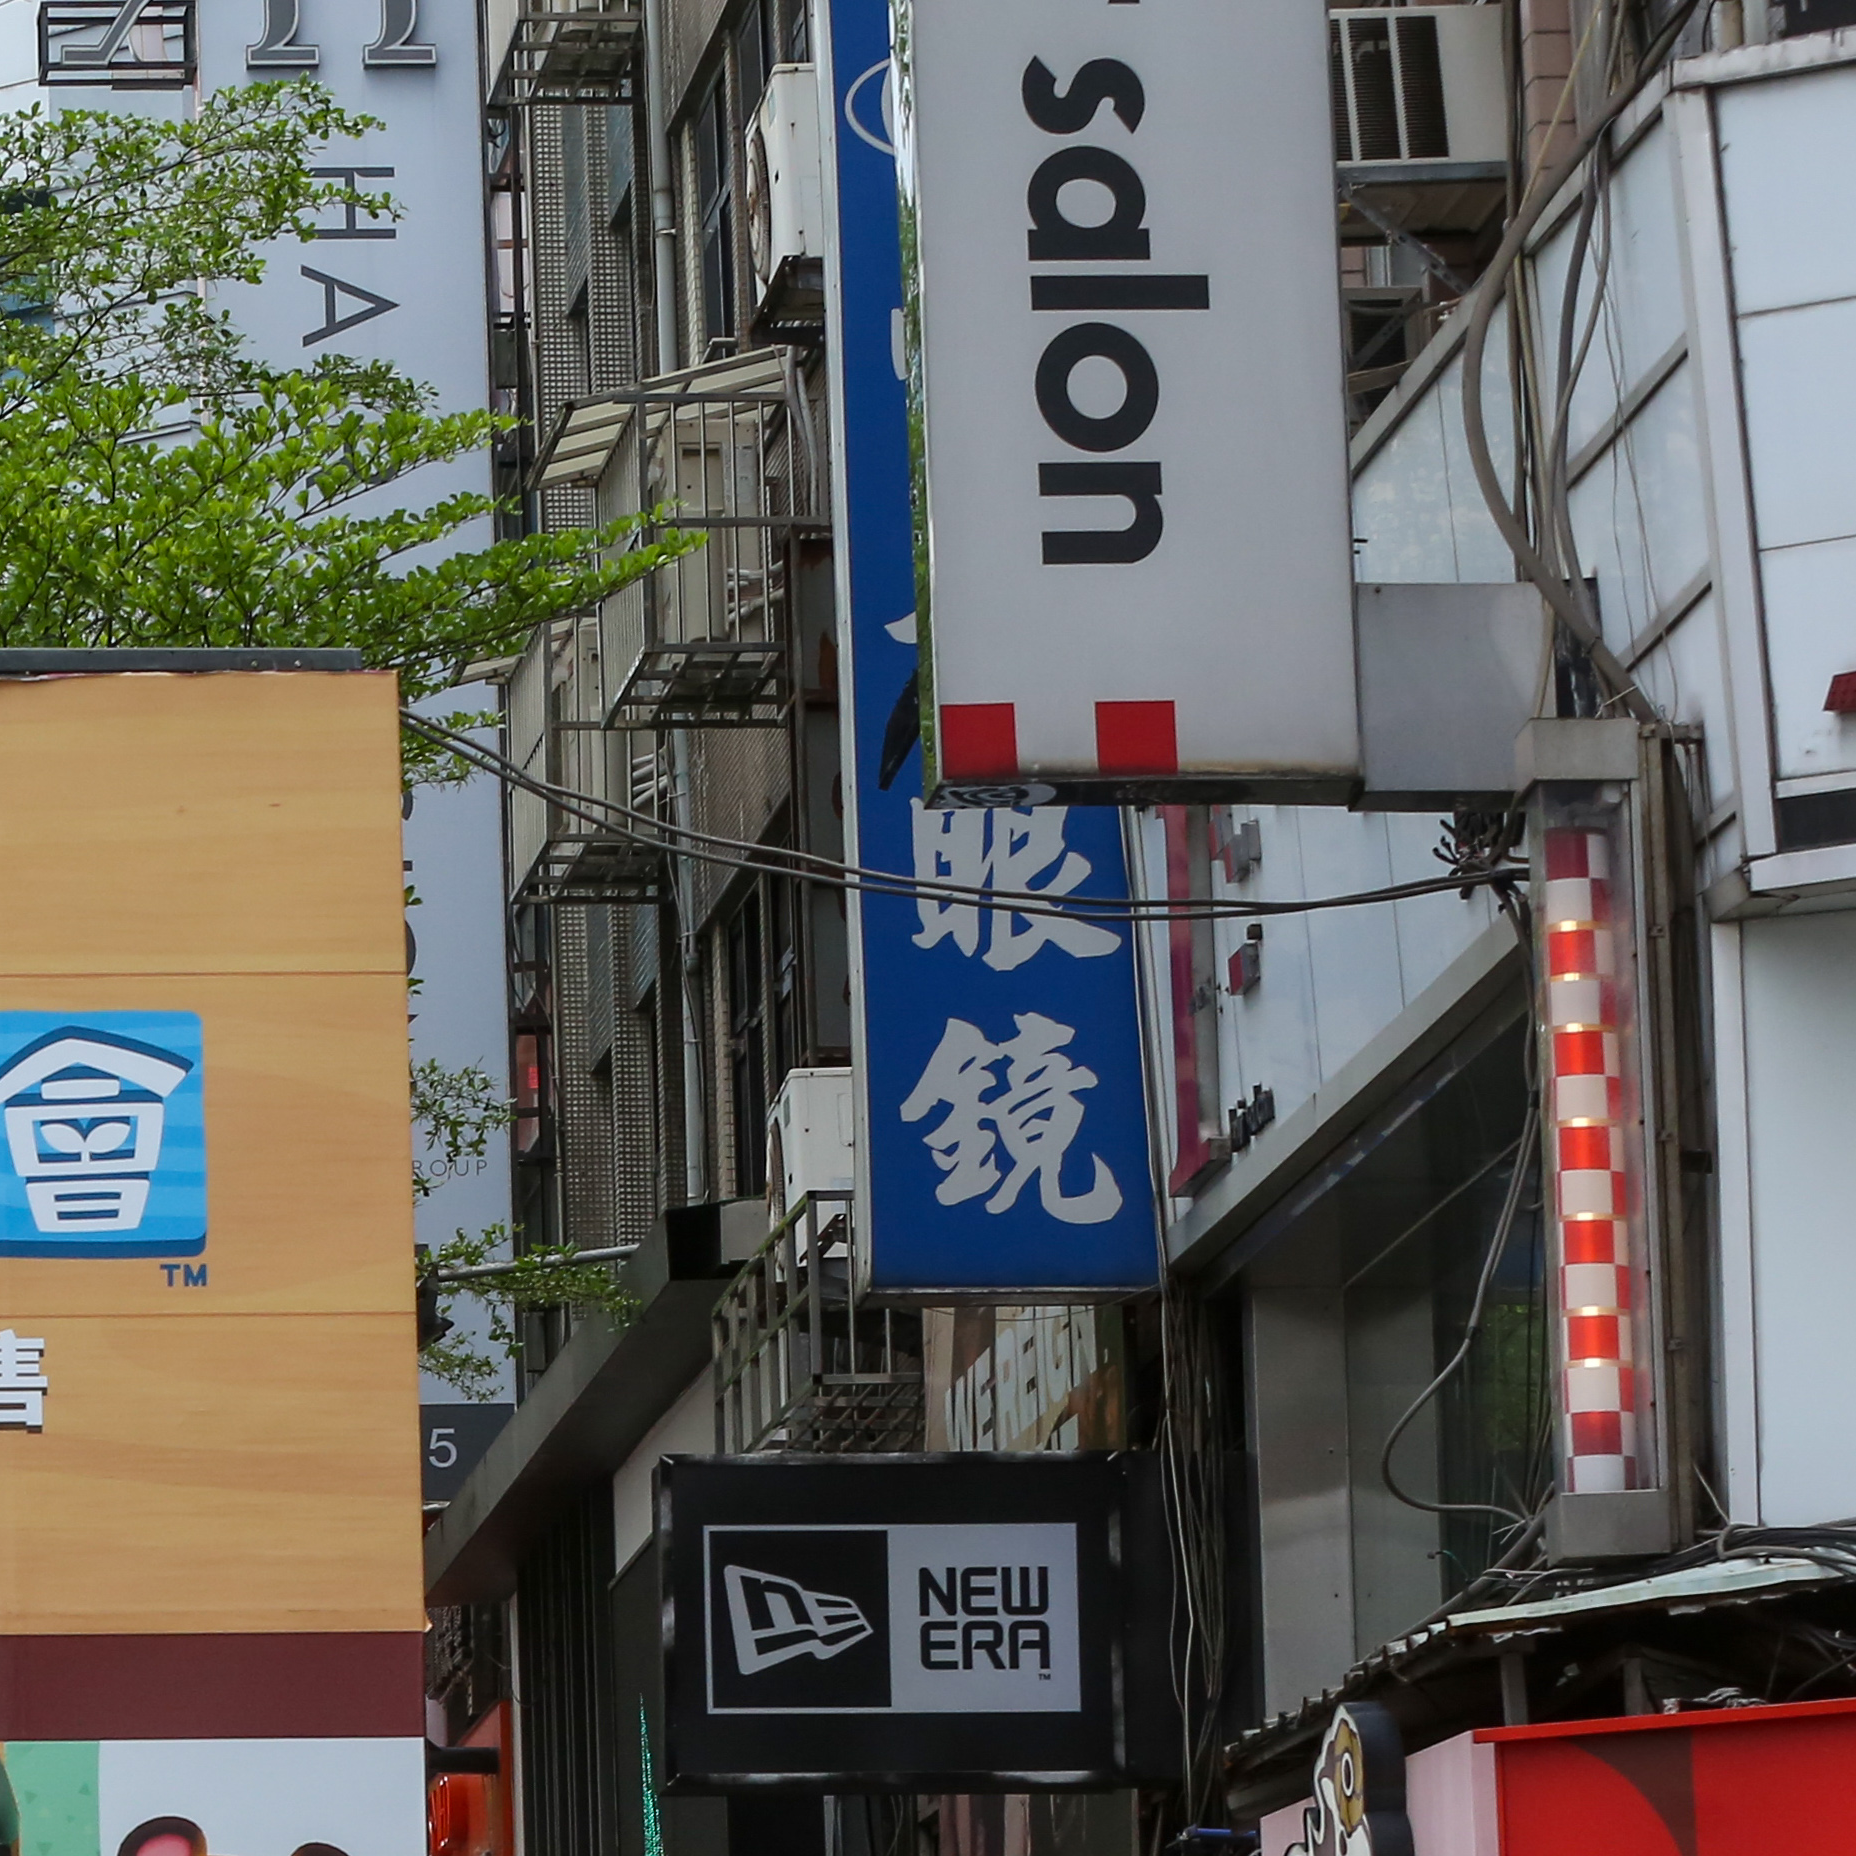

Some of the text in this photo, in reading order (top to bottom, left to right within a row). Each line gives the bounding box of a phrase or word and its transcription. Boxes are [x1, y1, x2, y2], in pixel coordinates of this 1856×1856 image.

[1022, 55, 1164, 567] salon
[900, 794, 1122, 1224] 眼鏡
[918, 1566, 1050, 1617] NEW
[920, 1620, 1052, 1671] ERA
